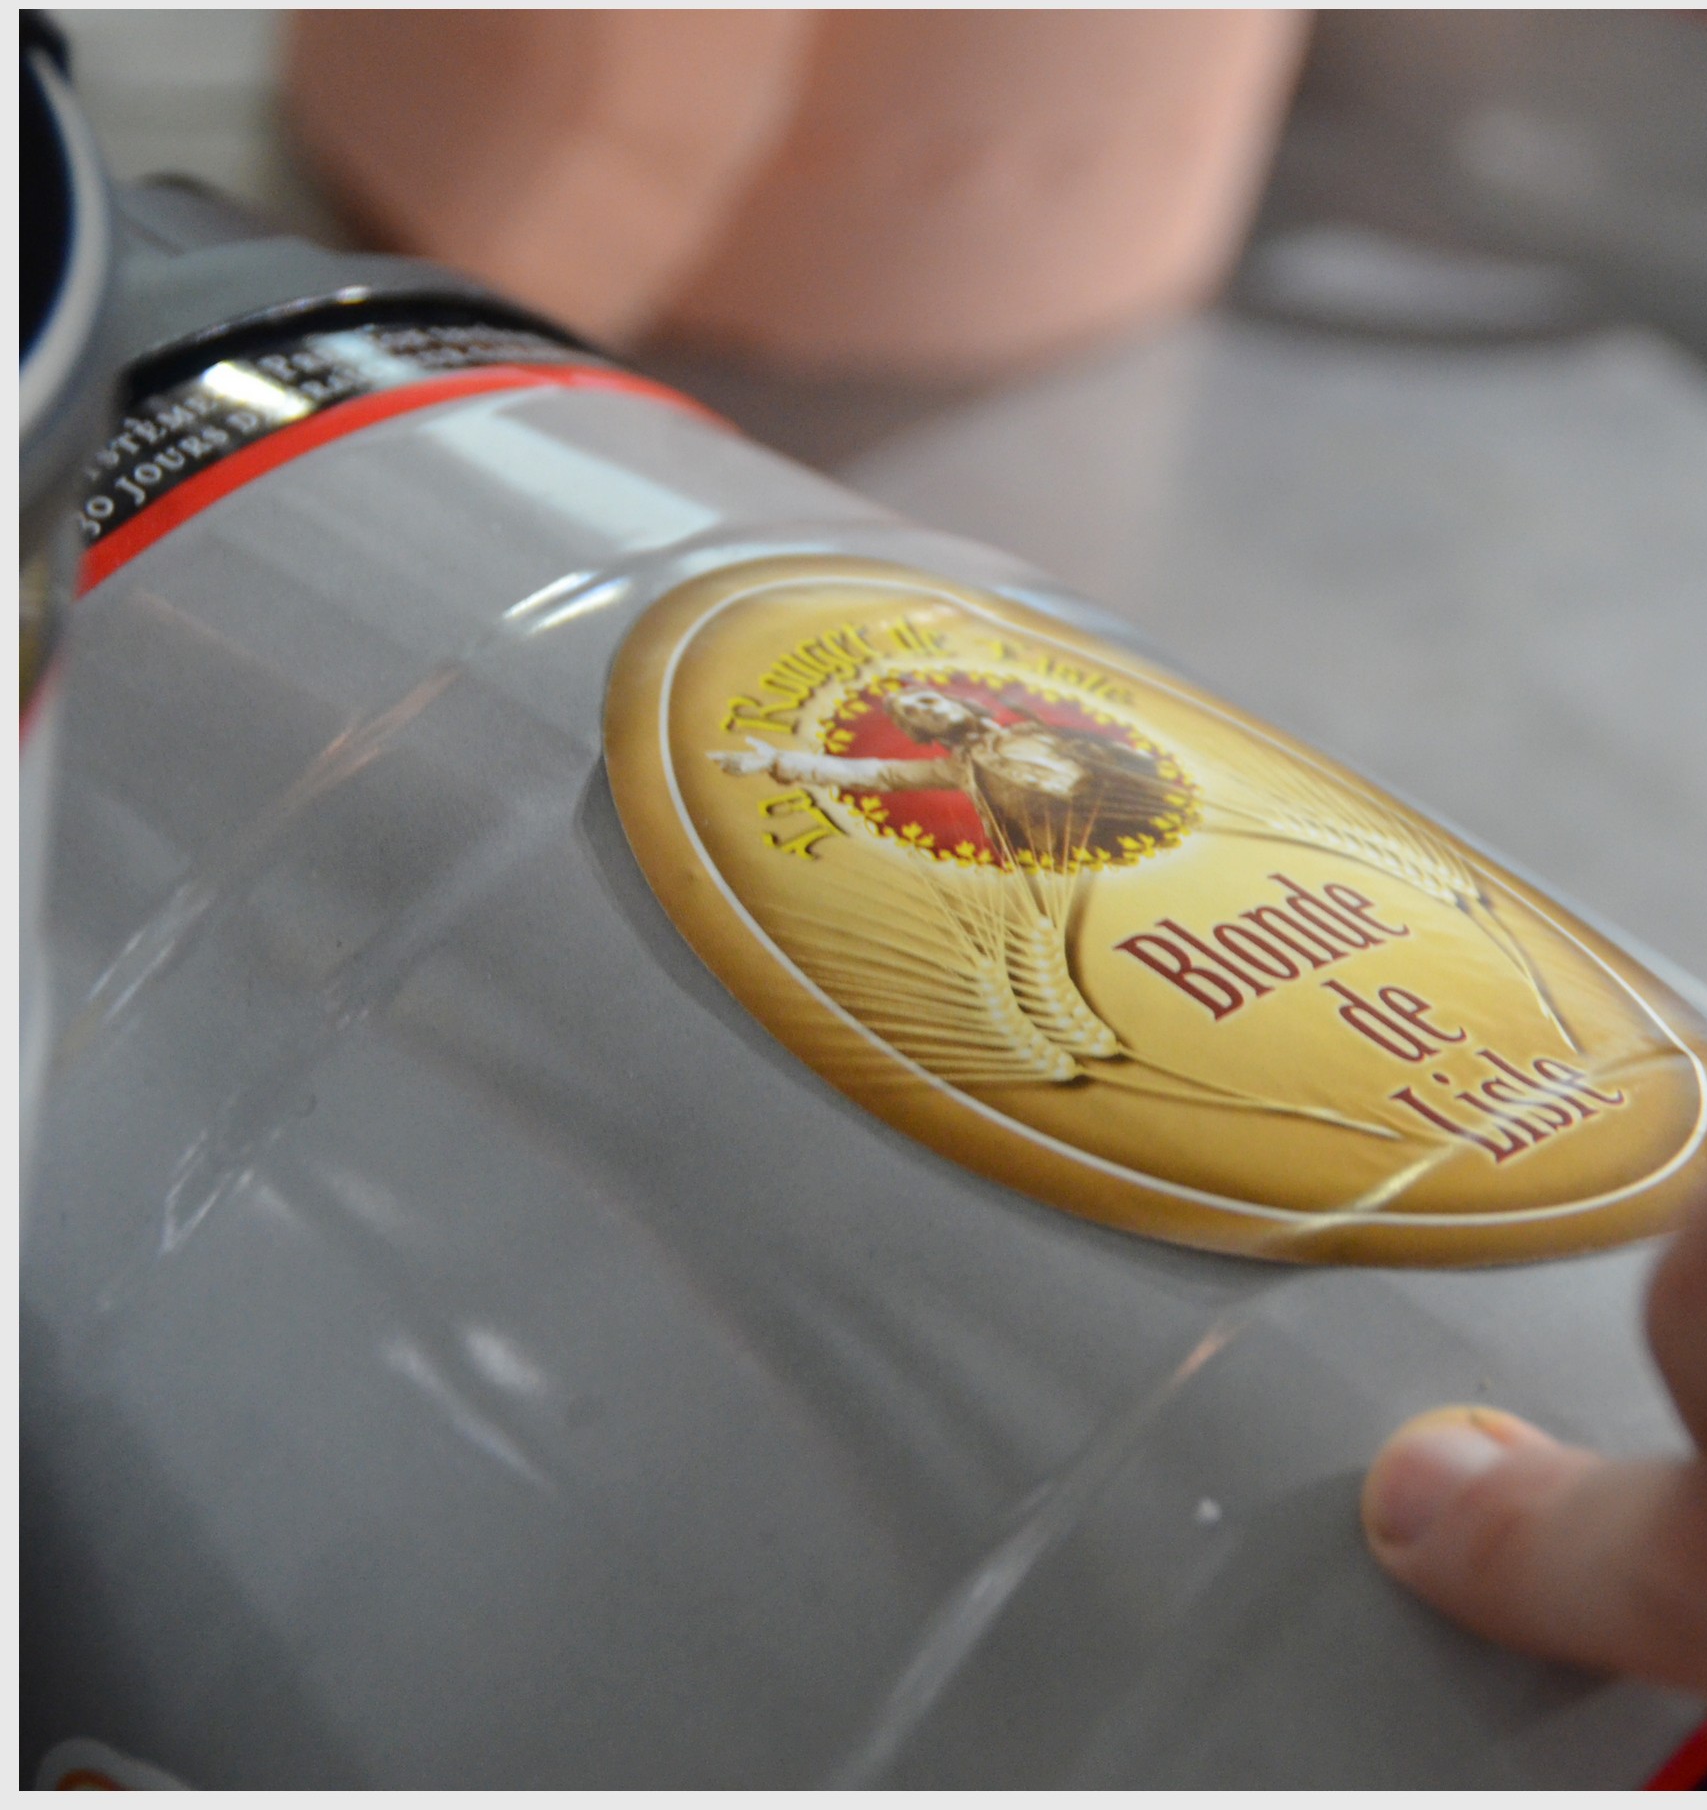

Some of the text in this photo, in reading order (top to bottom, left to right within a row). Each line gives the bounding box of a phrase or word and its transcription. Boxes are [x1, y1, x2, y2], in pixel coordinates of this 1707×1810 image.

[114, 424, 229, 507] JOURS
[720, 622, 876, 736] Rouget
[1112, 872, 1411, 1022] Blonde
[1321, 976, 1467, 1065] de
[1389, 1048, 1625, 1165] Lisle
